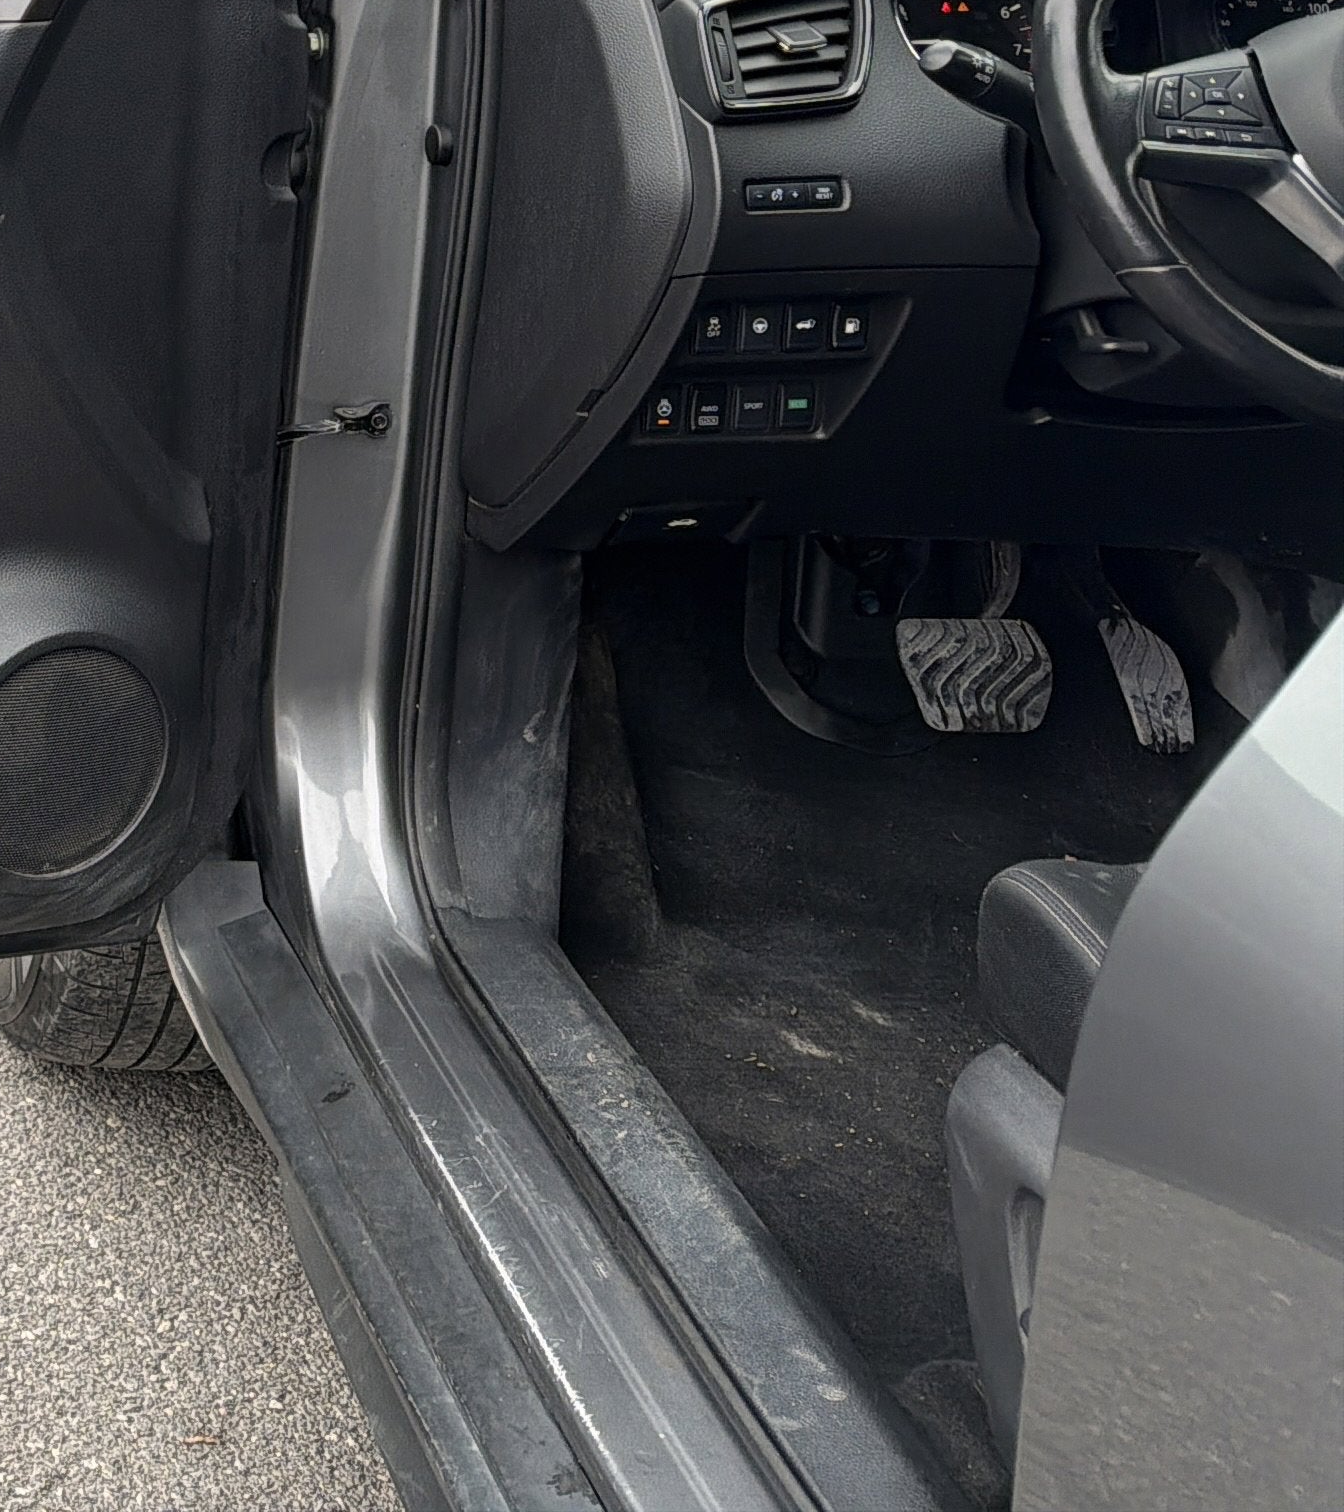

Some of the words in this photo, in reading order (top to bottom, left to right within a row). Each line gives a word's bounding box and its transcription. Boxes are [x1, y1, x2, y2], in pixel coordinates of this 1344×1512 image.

[1000, 6, 1010, 19] 6
[1308, 3, 1330, 14] 100
[1013, 43, 1023, 56] 7
